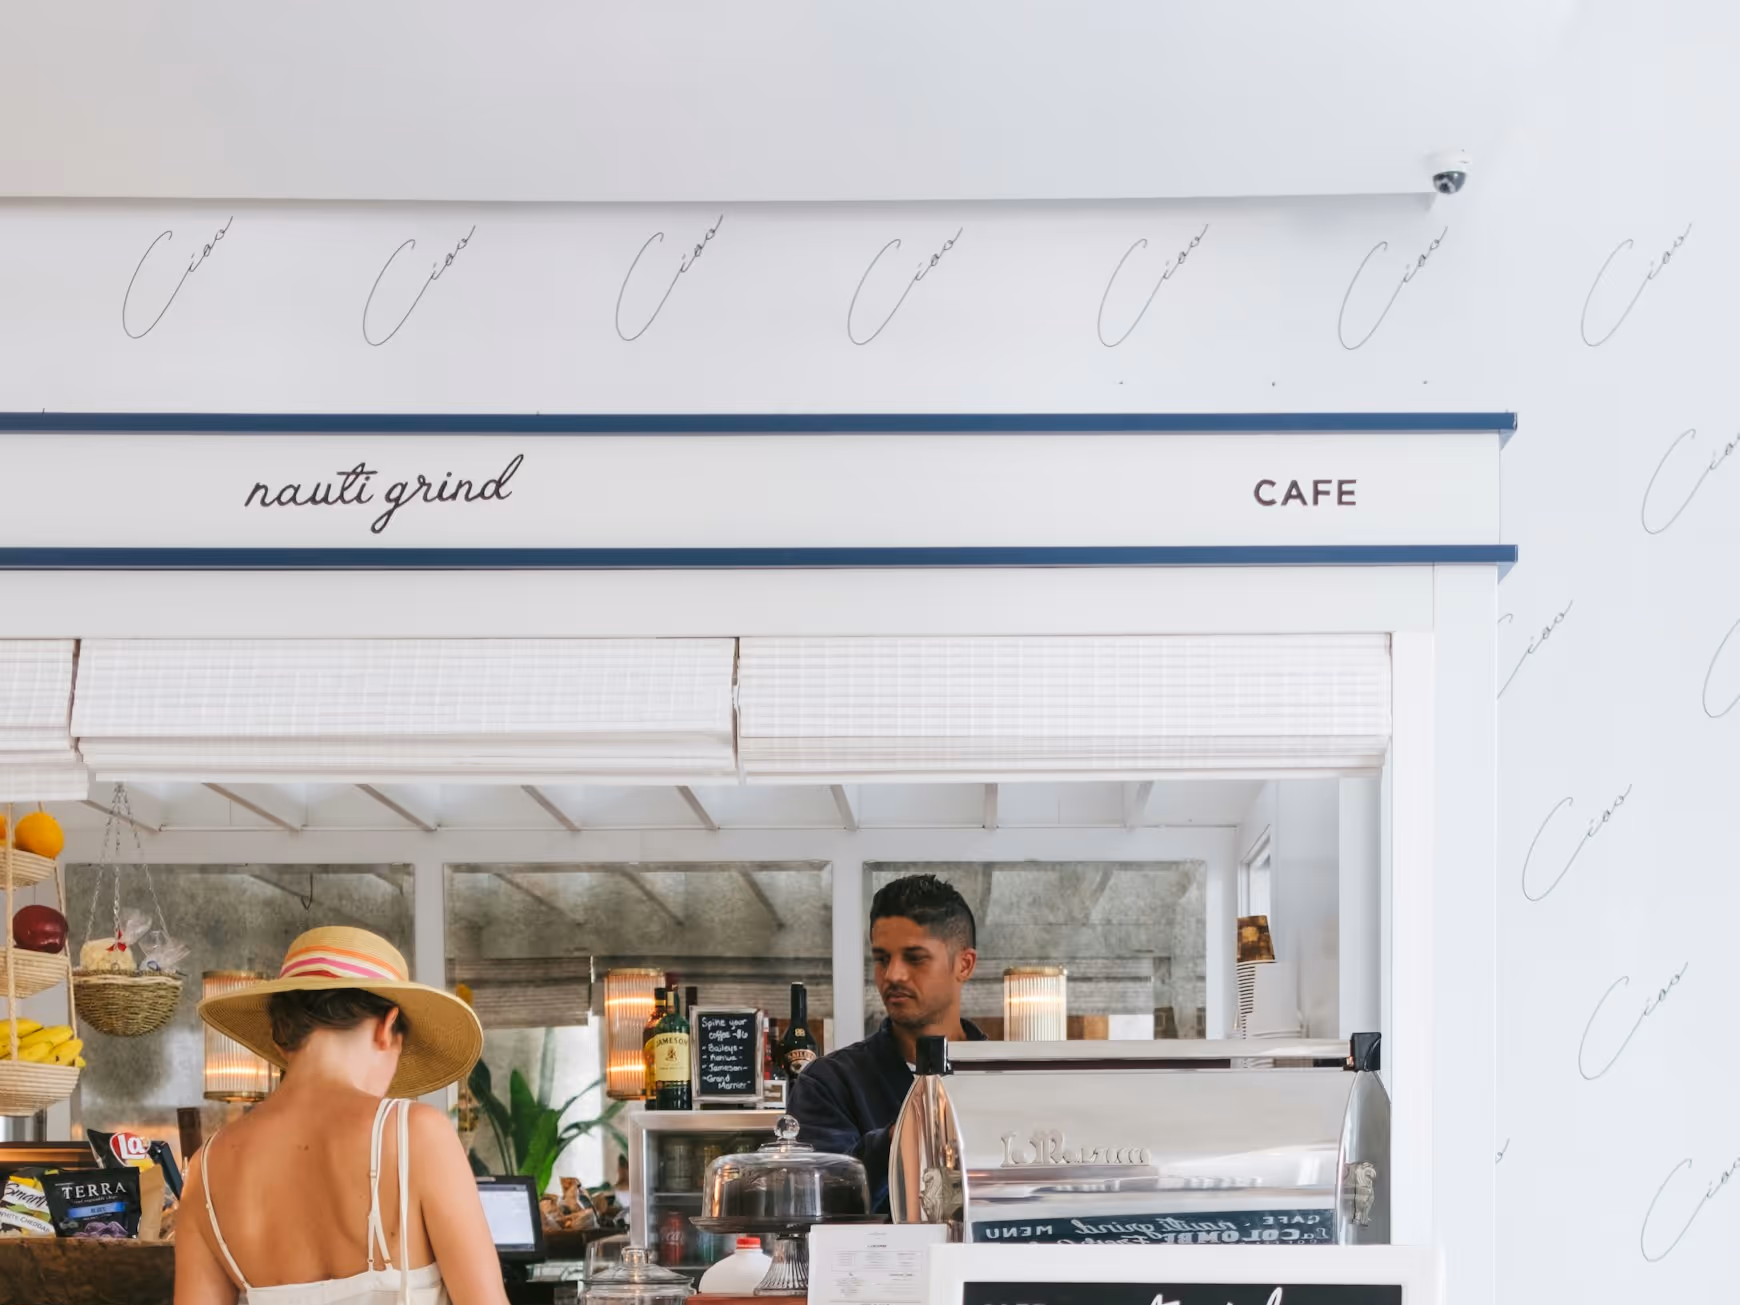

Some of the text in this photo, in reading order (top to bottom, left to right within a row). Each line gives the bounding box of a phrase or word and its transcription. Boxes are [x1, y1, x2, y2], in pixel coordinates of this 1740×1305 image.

[122, 216, 234, 340] Ciao
[363, 225, 477, 347] Ciao
[615, 215, 725, 342] Ciao
[847, 227, 964, 346] Ciao
[1097, 224, 1209, 348] Ciao
[1338, 226, 1449, 351] Ciao
[1581, 223, 1693, 348] Ciao
[244, 453, 525, 535] nauti grind
[1253, 478, 1359, 508] CAFE
[1522, 783, 1633, 902] Ciao
[1578, 961, 1689, 1081] Ciao
[61, 1182, 126, 1200] TERRA
